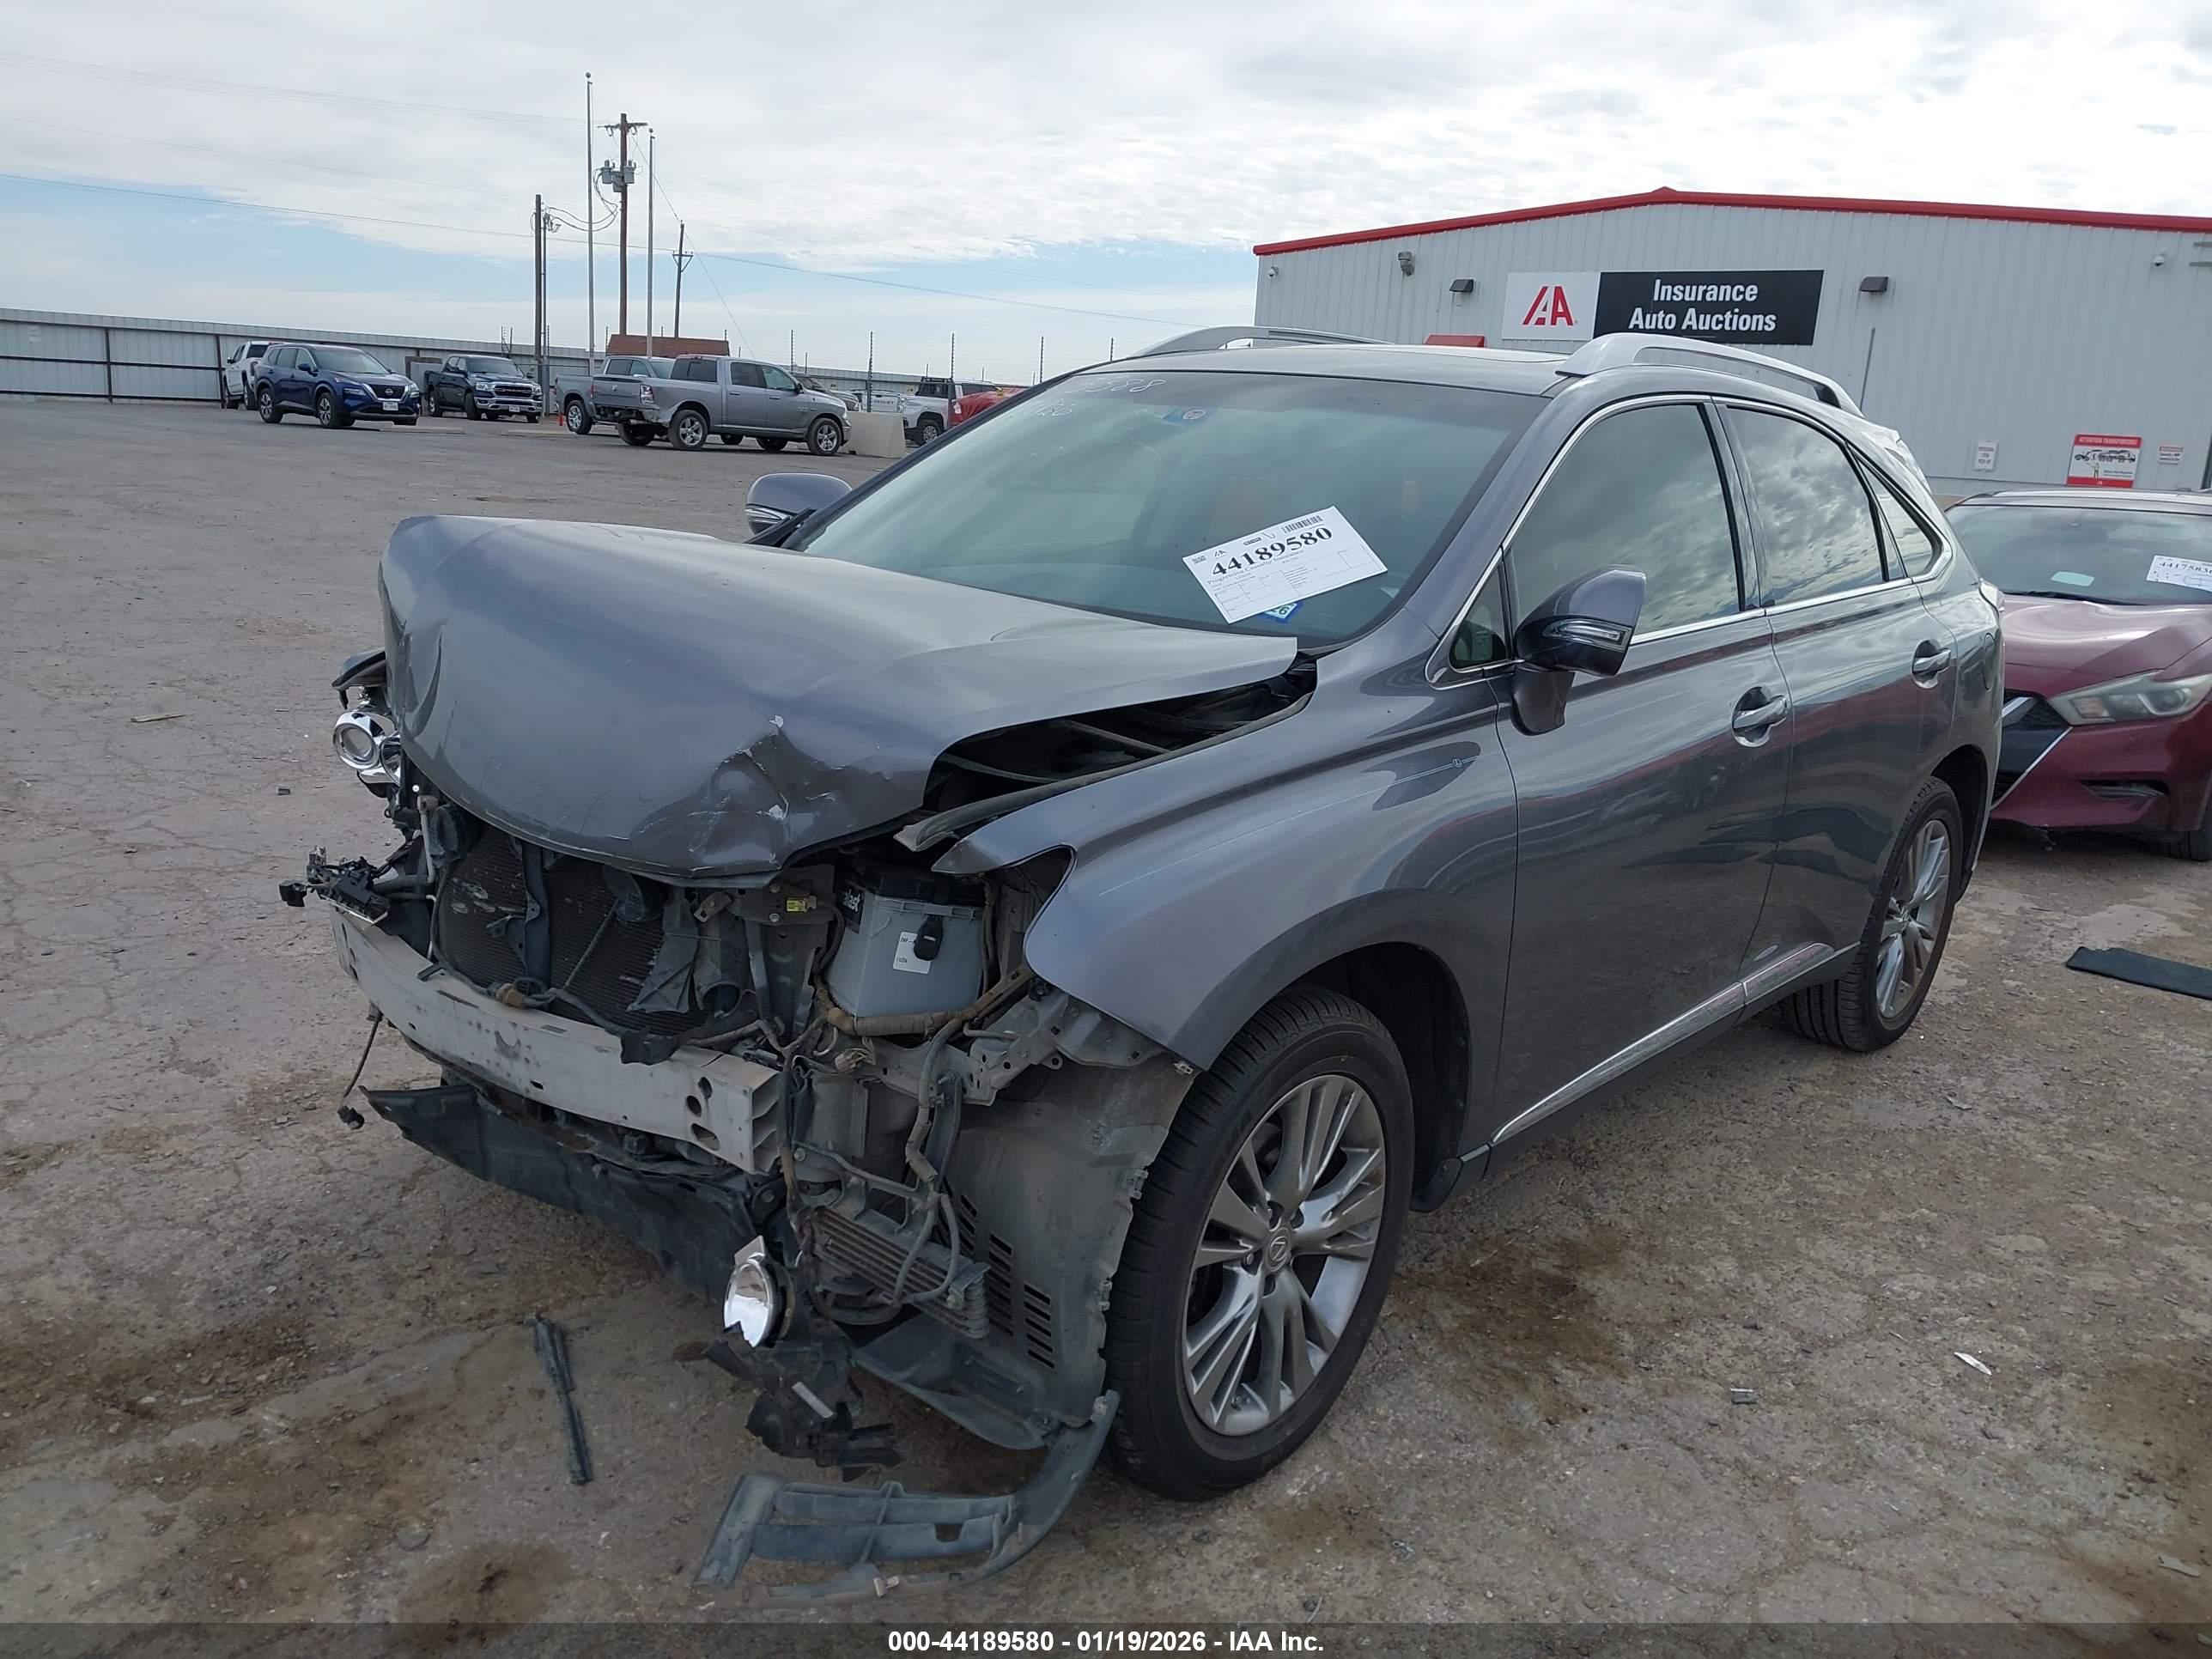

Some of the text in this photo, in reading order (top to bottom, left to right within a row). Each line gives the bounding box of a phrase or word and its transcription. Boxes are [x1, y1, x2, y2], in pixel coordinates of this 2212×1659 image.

[1653, 279, 1758, 301] Insurance
[1629, 307, 1777, 331] Auto Auctions
[1212, 527, 1332, 576] 44189580
